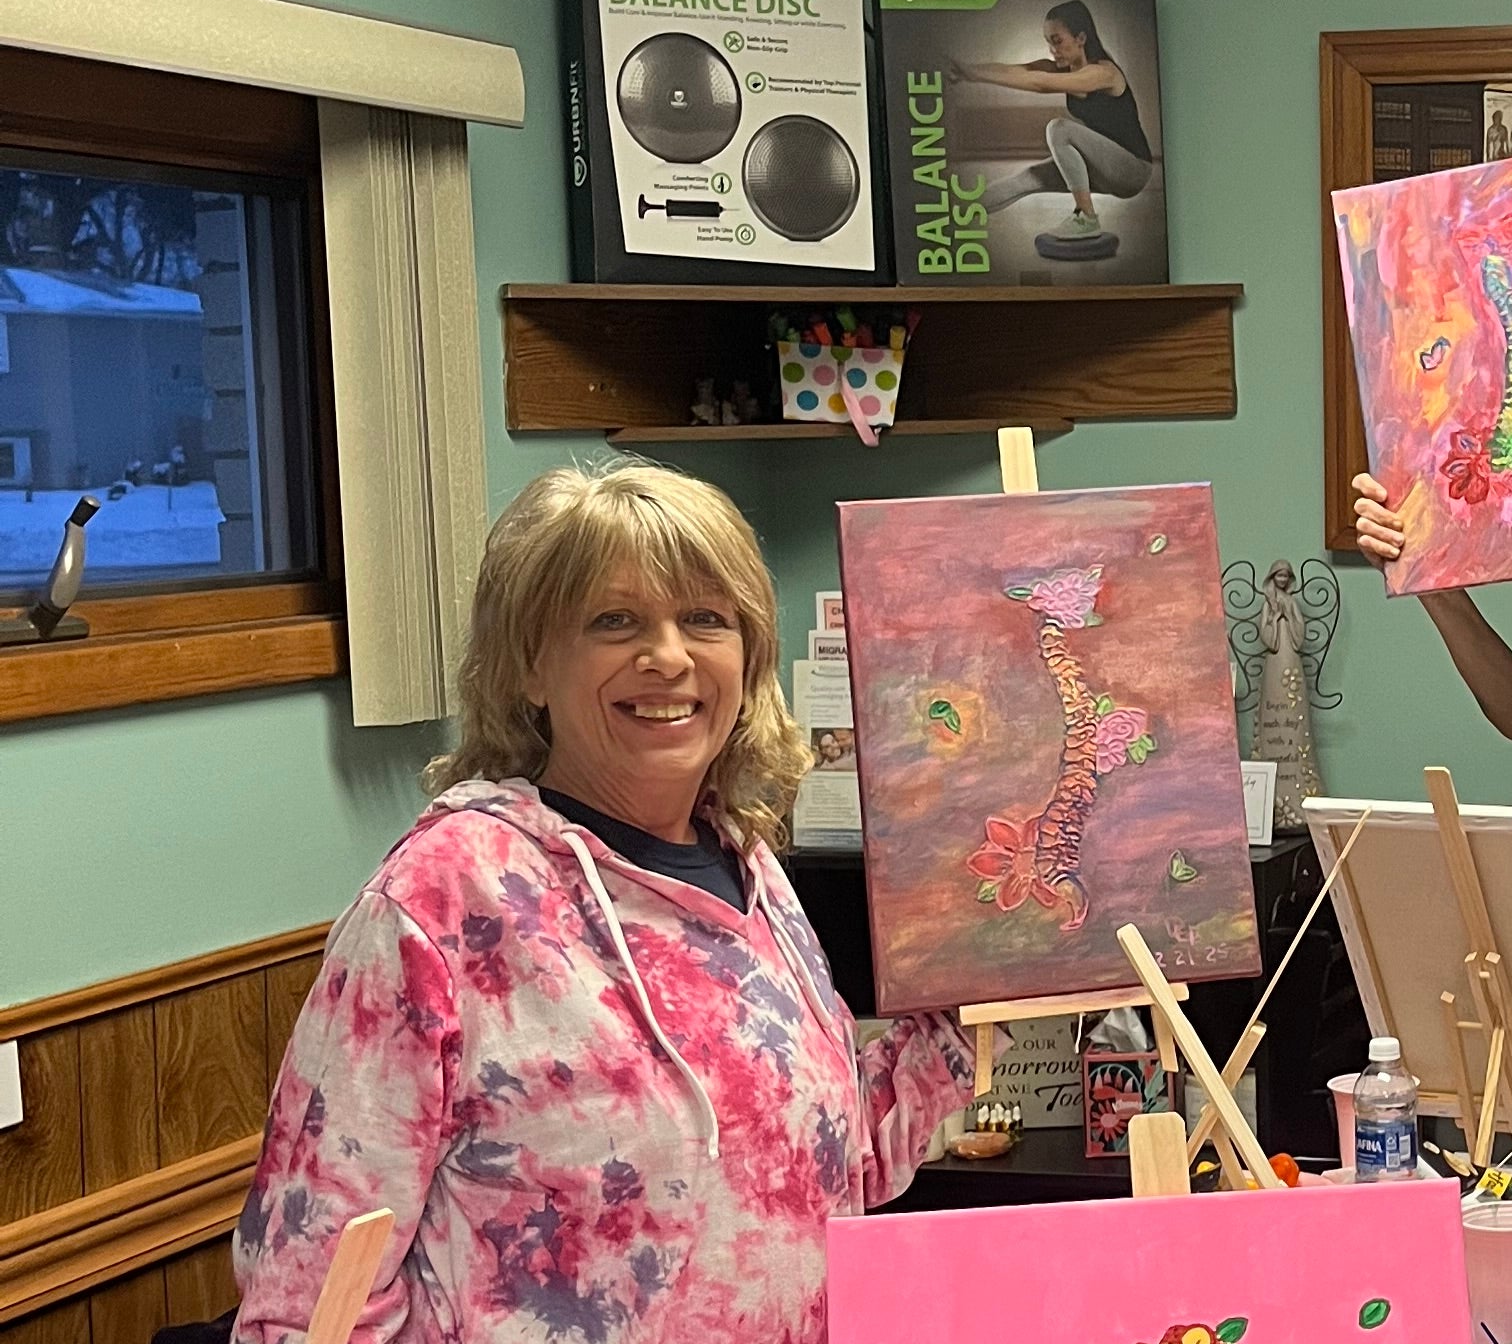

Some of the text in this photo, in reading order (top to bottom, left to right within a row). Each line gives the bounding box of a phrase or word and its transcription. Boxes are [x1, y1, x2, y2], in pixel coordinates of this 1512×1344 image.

[907, 71, 953, 274] BALANCE
[951, 173, 991, 274] DISC
[818, 646, 848, 655] MIGRA
[1023, 1039, 1057, 1051] OUR
[1007, 1084, 1032, 1095] WE
[1357, 1139, 1383, 1153] AFINA
